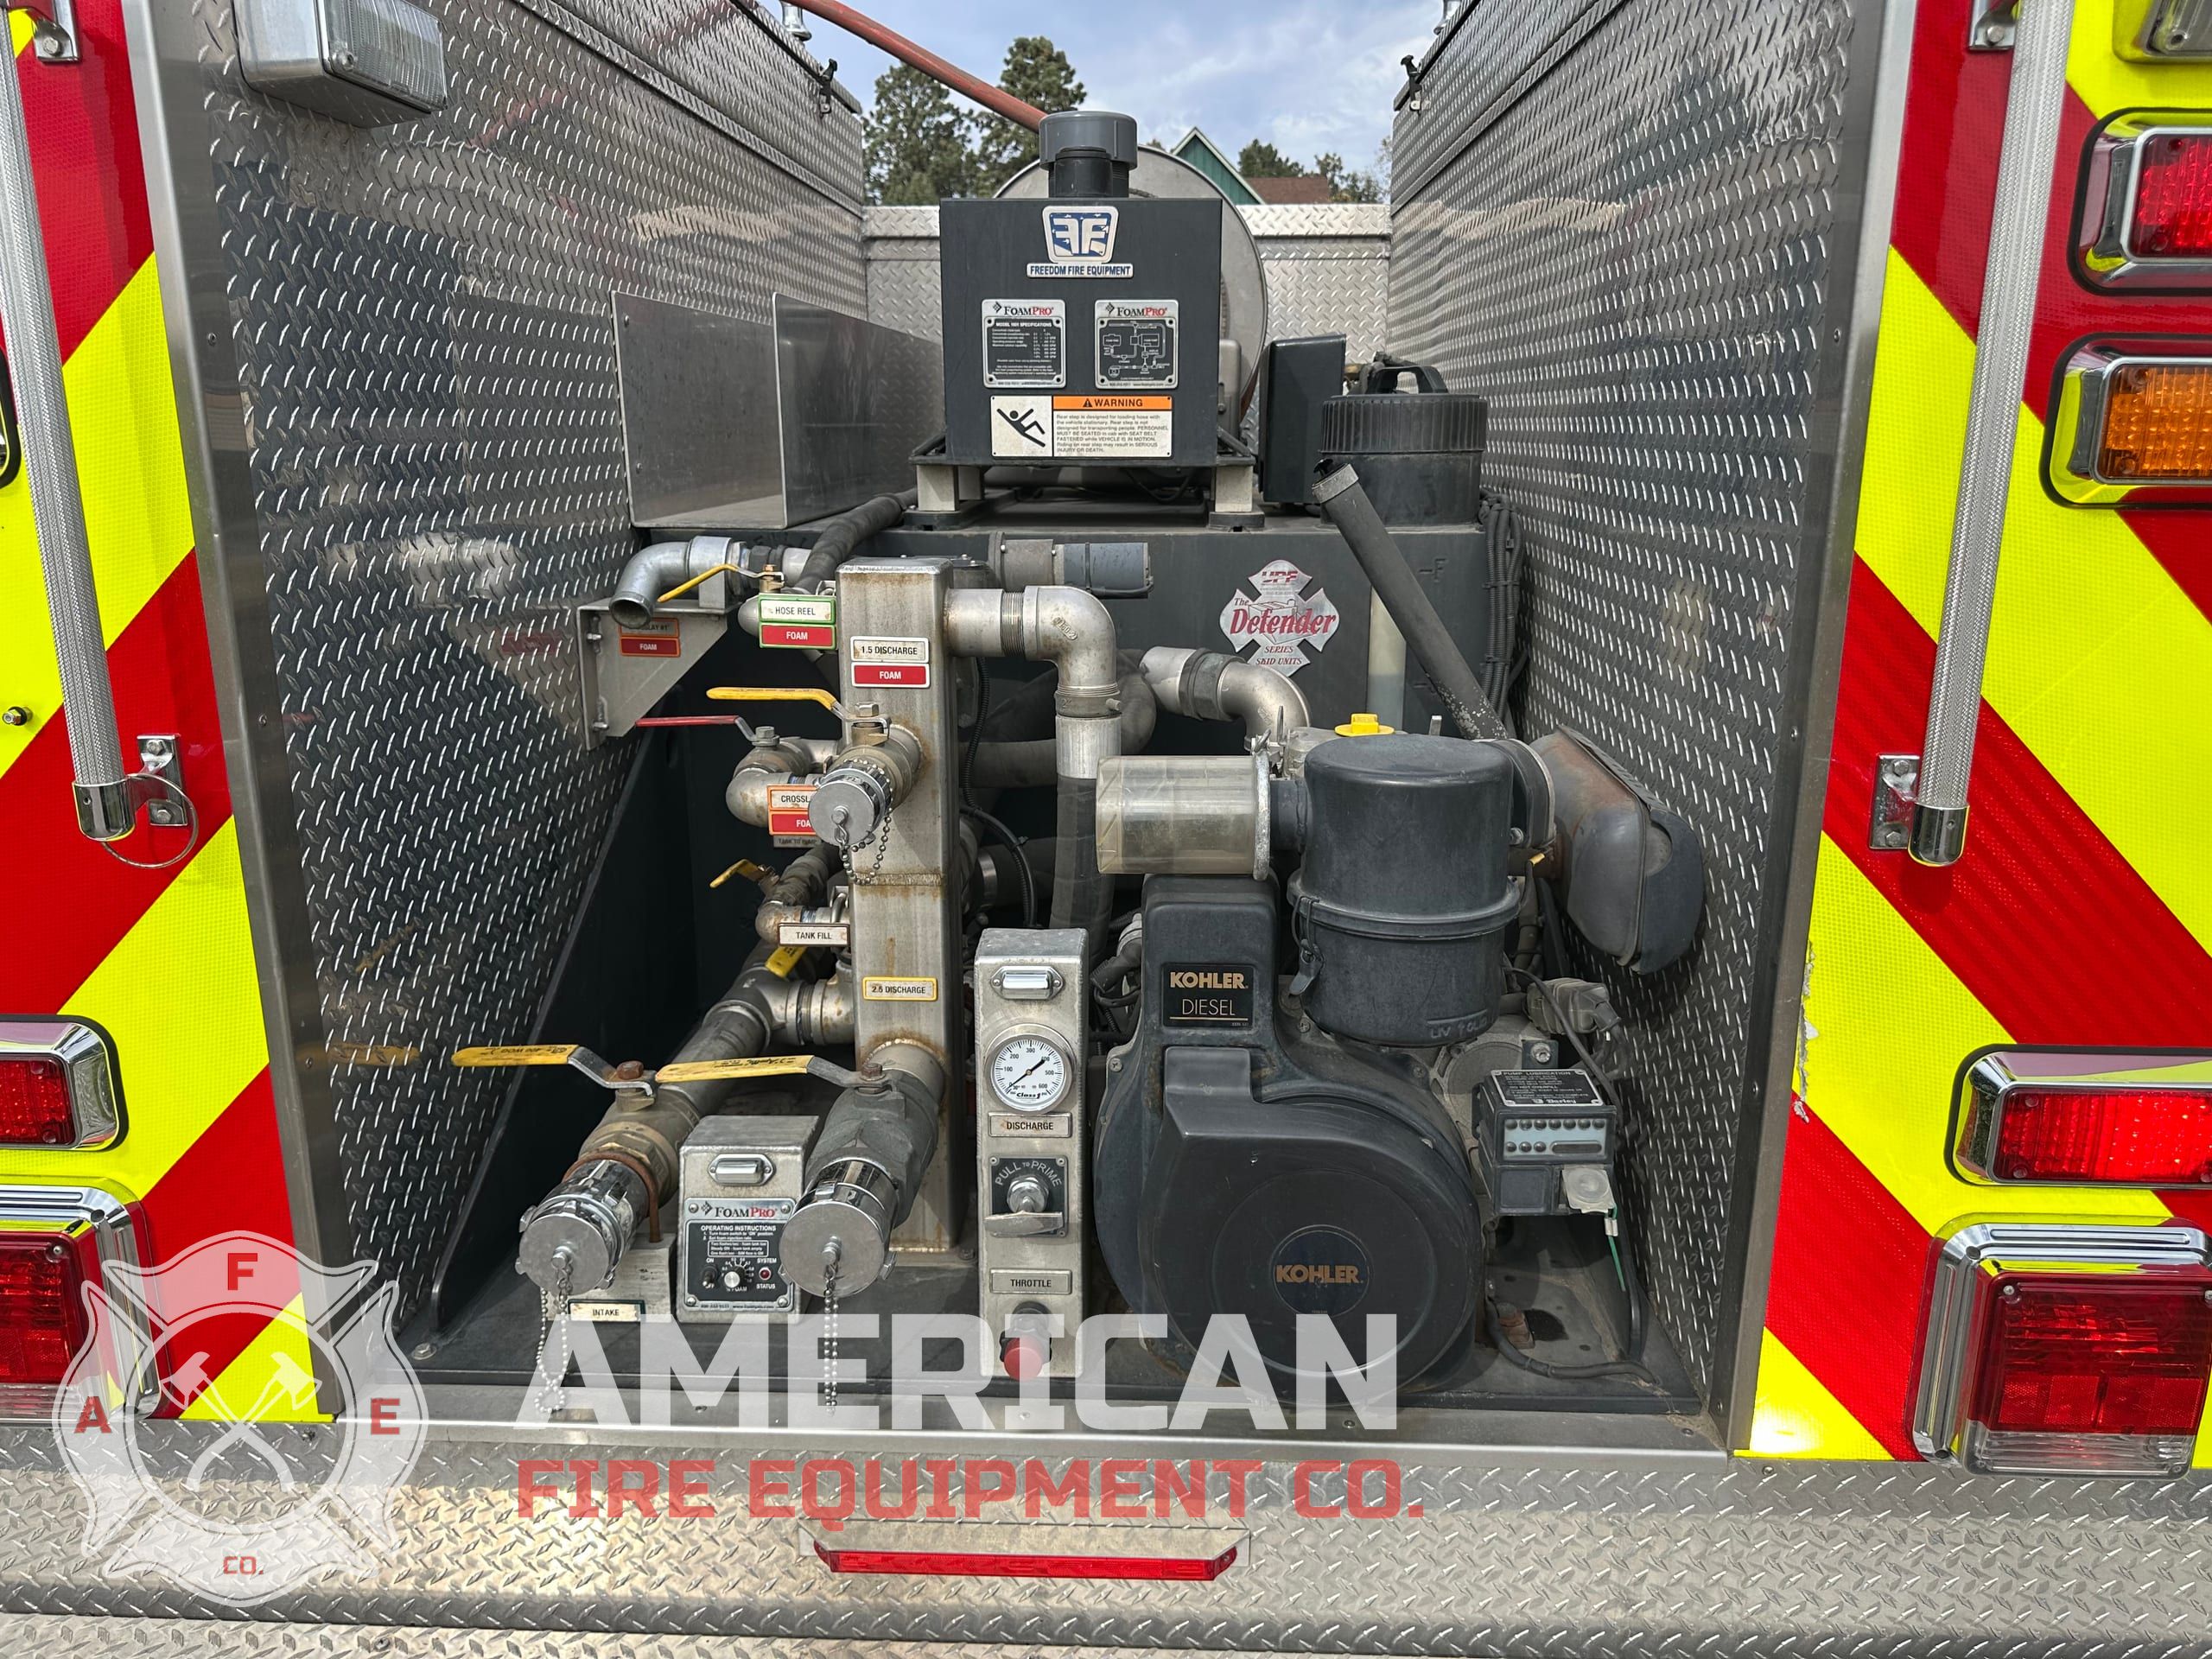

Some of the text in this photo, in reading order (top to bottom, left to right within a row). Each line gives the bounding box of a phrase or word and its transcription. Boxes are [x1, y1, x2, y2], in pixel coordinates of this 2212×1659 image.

[1030, 265, 1131, 276] FREEDOM FIRE EQUIPMENT
[1094, 398, 1143, 407] WARNING
[1262, 571, 1299, 583] UPF
[775, 606, 817, 616] HOSE REEL
[1230, 608, 1337, 634] Defender
[785, 631, 808, 641] FOAM
[861, 645, 918, 656] 1.5 DISCHARGE
[879, 671, 902, 680] FOAM
[796, 819, 811, 828] FOA
[796, 931, 832, 940] TANK FILL
[1170, 971, 1246, 989] KOHLER
[885, 986, 926, 995] DISCHARGE
[1182, 998, 1236, 1016] DIESEL
[1006, 1122, 1054, 1131] DISCHARGE
[995, 1161, 1022, 1186] PULL
[1031, 1160, 1063, 1187] PRIME
[1275, 1264, 1360, 1284] KOHLER
[1010, 1279, 1052, 1287] THROTTLE
